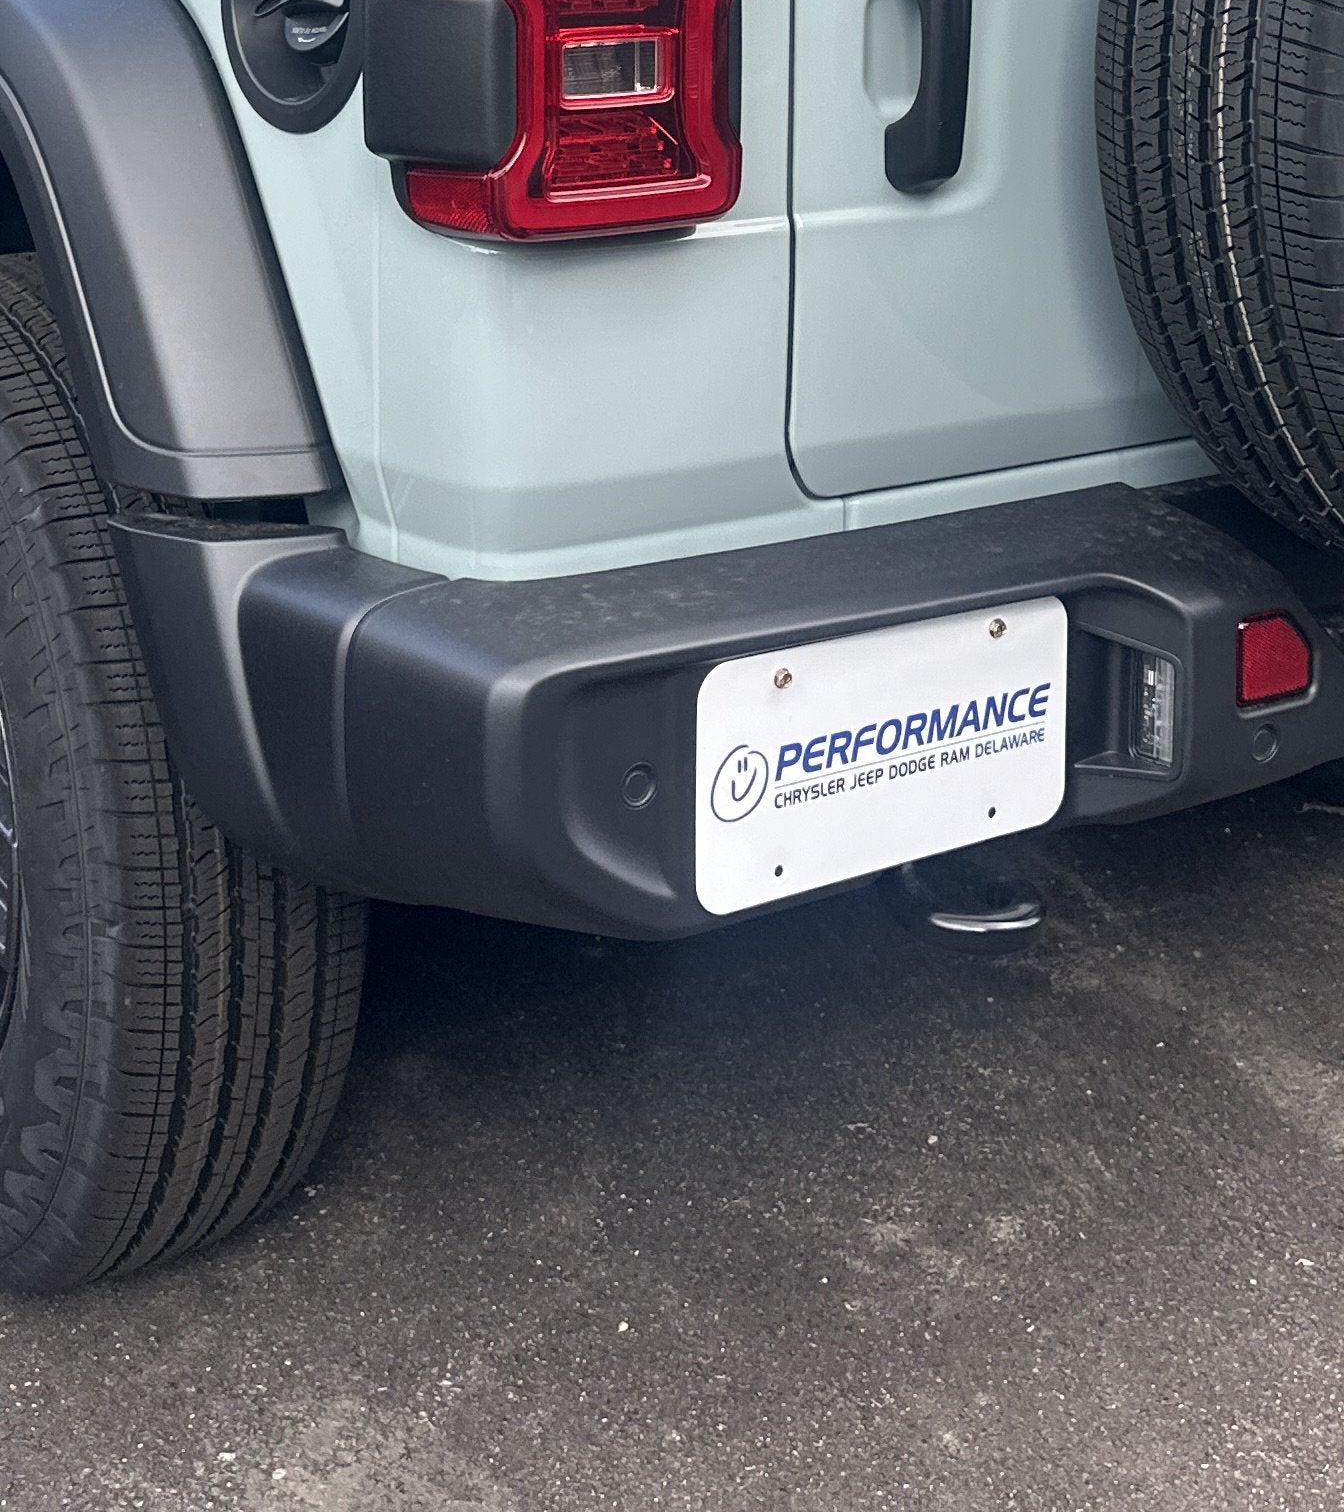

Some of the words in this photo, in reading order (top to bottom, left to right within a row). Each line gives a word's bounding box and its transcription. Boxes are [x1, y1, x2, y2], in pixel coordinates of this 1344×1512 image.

[774, 682, 1052, 781] PERFORMANCE
[774, 778, 846, 809] CHRYSLER
[849, 768, 884, 790] JEEP
[888, 755, 936, 781] DODGE
[940, 746, 970, 767] RAM
[974, 727, 1046, 760] DELAWARE
